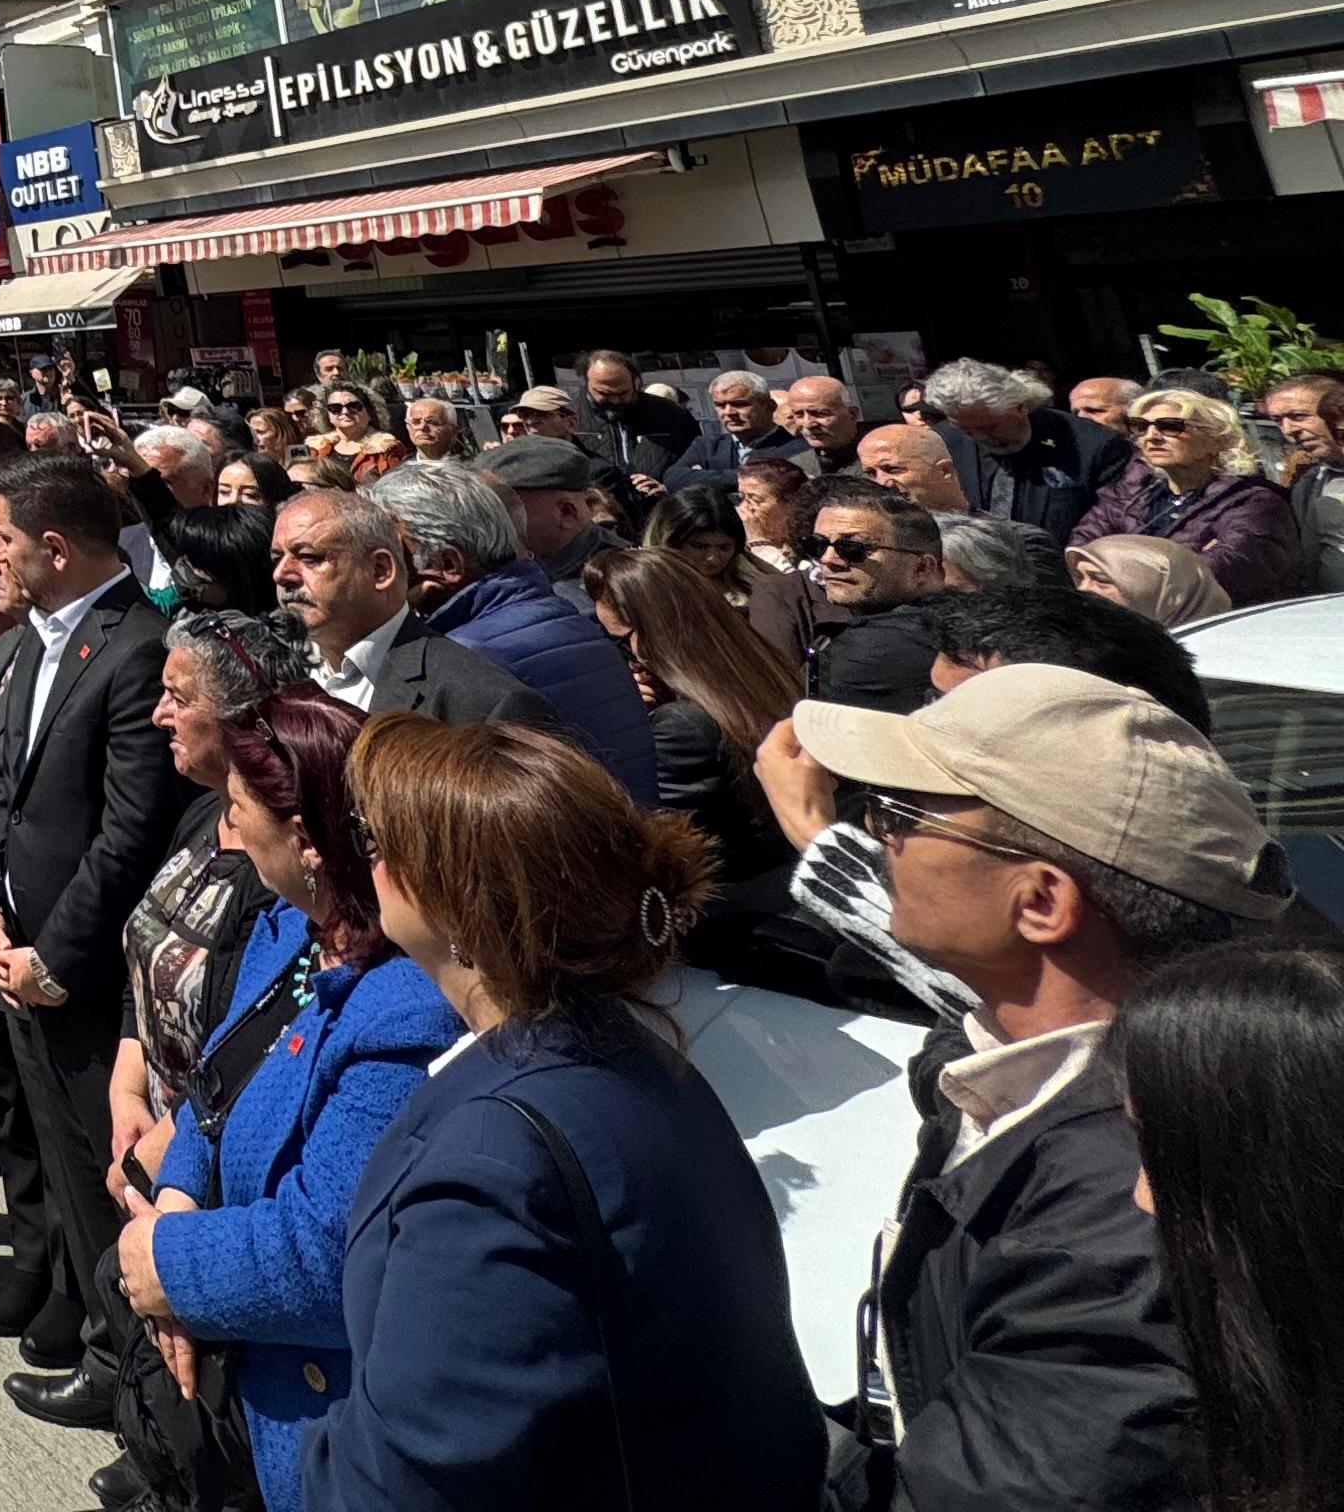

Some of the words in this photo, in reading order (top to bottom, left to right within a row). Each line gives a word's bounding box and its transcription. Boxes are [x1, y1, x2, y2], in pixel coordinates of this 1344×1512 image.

[279, 33, 467, 111] EPİLASYON
[472, 30, 502, 68] &
[611, 31, 734, 75] Güvenpark
[178, 80, 266, 110] Linessa
[16, 145, 71, 180] NBB
[878, 143, 1071, 188] MÜDAFAA
[11, 175, 80, 208] OUTLET
